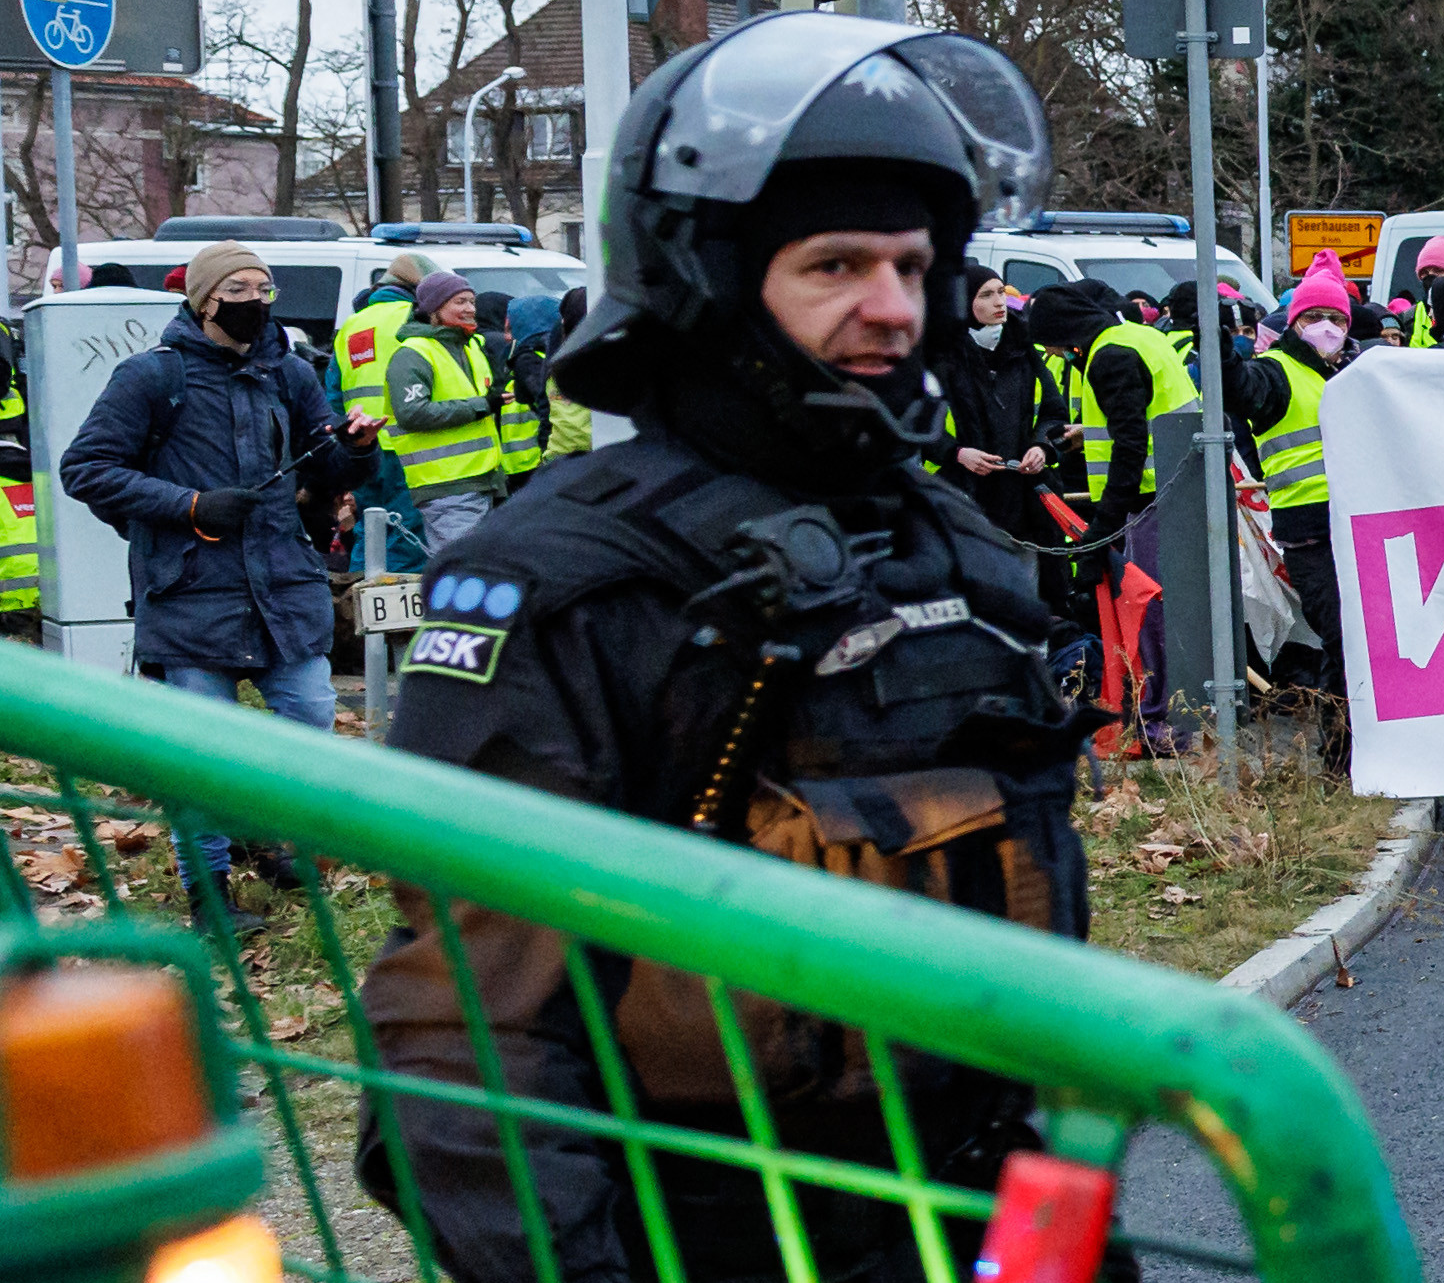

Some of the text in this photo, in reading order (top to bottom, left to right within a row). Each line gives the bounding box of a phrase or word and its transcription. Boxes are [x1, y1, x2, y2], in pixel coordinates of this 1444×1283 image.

[1297, 220, 1360, 232] Seerhausen
[373, 597, 387, 621] B
[411, 629, 489, 669] USK
